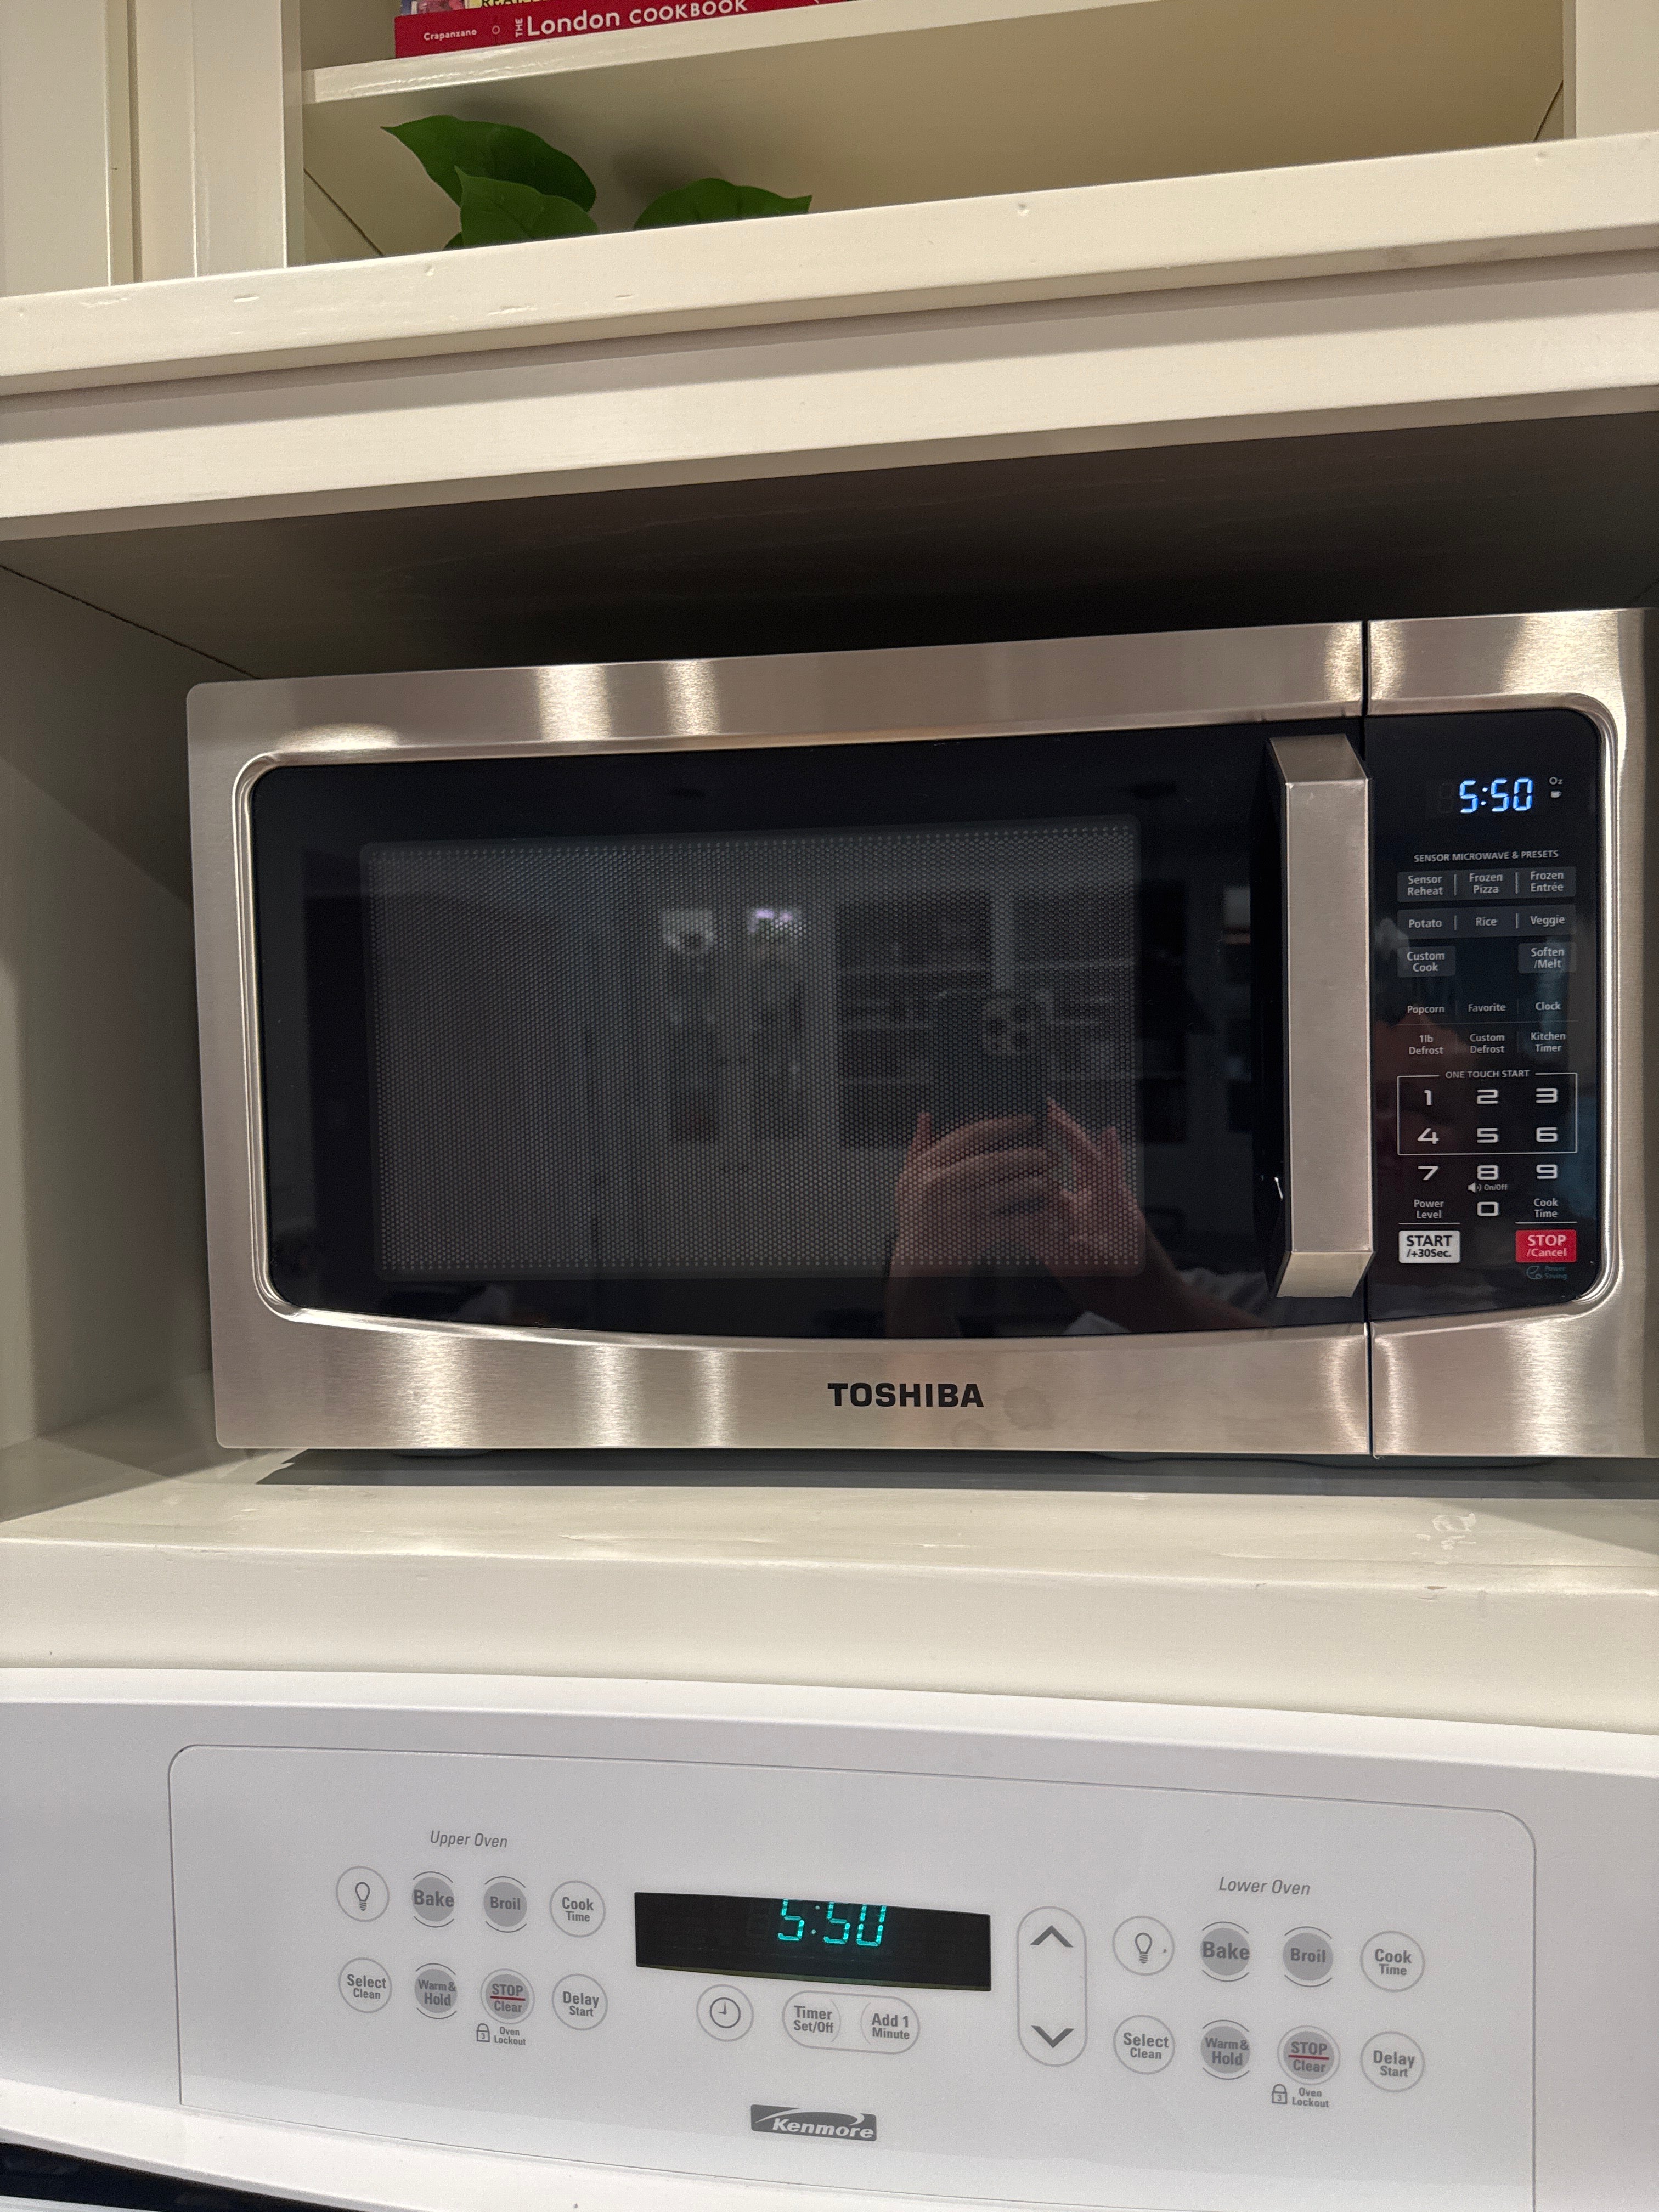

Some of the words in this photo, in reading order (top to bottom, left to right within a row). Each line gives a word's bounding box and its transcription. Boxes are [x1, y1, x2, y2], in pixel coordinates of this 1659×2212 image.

[527, 9, 620, 37] London
[629, 0, 748, 24] COOKBOOK
[424, 29, 477, 41] Crapanzano
[1459, 777, 1533, 814] 5:50
[1414, 854, 1449, 863] SENSOR
[1452, 851, 1510, 861] MICROWAVE
[1521, 850, 1559, 859] PRESETS
[1408, 875, 1442, 884] Sensor
[1469, 873, 1503, 882] Frozen
[1530, 871, 1564, 880] Frozen
[1407, 887, 1443, 896] Reheat
[1473, 884, 1499, 894] Pizza
[1531, 882, 1564, 891] Entrée
[1408, 919, 1442, 928] Potato
[1475, 917, 1497, 926] Rice
[1530, 915, 1565, 927] Veggie
[1407, 951, 1445, 961] Custom
[1531, 947, 1565, 957] Soften
[1413, 963, 1438, 972] Cook
[1533, 960, 1561, 968] /Melt
[1407, 1005, 1444, 1015] Popcorn
[1468, 1003, 1506, 1012] Favorite
[1535, 1002, 1561, 1011] Clock
[1419, 1035, 1434, 1043] 1lb
[1470, 1034, 1505, 1042] Custom
[1531, 1032, 1566, 1040] Kitchen
[1409, 1046, 1444, 1055] Defrost
[1470, 1045, 1505, 1053] Defrost
[1535, 1044, 1562, 1052] Timer
[1424, 1090, 1432, 1106] 1
[1476, 1089, 1499, 1104] 2
[1536, 1088, 1558, 1103] 3
[1417, 1128, 1440, 1144] 4
[1476, 1128, 1499, 1143] 5
[1536, 1127, 1558, 1142] 6
[1418, 1166, 1439, 1181] 7
[1477, 1165, 1499, 1180] 8
[1536, 1164, 1558, 1180] 9
[1533, 1198, 1558, 1206] Cook
[1417, 1210, 1442, 1219] Level
[1534, 1209, 1558, 1218] Time
[1406, 1235, 1452, 1247] START
[1527, 1234, 1567, 1246] STOP
[1407, 1249, 1451, 1258] /+30Sec.
[1526, 1248, 1567, 1257] /Cancel
[827, 1383, 984, 1408] TOSHIBA
[430, 1830, 471, 1847] Upper
[475, 1833, 508, 1848] Oven
[1218, 1877, 1267, 1893] Lower
[1272, 1880, 1311, 1895] Oven
[413, 1889, 454, 1908] Bake
[490, 1897, 521, 1911] Broil
[562, 1897, 594, 1911] Cook
[566, 1910, 590, 1922] Time
[1203, 1941, 1250, 1960] Bake
[1290, 1948, 1326, 1963] Broil
[1375, 1949, 1412, 1964] Cook
[1379, 1964, 1407, 1976] Time
[347, 1974, 387, 1989] Select
[418, 1979, 447, 1991] Warm
[448, 1982, 456, 1992] &
[353, 1988, 381, 2000] Clean
[492, 1984, 524, 1997] STOP
[424, 1993, 452, 2006] Hold
[562, 1991, 600, 2008] Delay
[494, 2000, 523, 2013] Clear
[569, 2006, 594, 2017] Start
[794, 2005, 832, 2020] Timer
[794, 2020, 834, 2033] Set/Off
[871, 2013, 898, 2027] Add
[902, 2016, 909, 2028] 1
[499, 2027, 520, 2036] Oven
[872, 2027, 910, 2040] Minute
[494, 2036, 527, 2046] Lockout
[1123, 2032, 1169, 2048] Select
[1205, 2037, 1239, 2050] Warm
[1239, 2040, 1250, 2050] &
[1130, 2047, 1162, 2060] Clean
[1290, 2041, 1328, 2055] STOP
[1211, 2050, 1243, 2066] Hold
[1373, 2050, 1415, 2068] Delay
[1293, 2059, 1326, 2073] Clear
[1380, 2065, 1408, 2078] Start
[1298, 2088, 1322, 2098] Oven
[1291, 2098, 1330, 2108] Lockout
[772, 2118, 874, 2138] Kenmore
